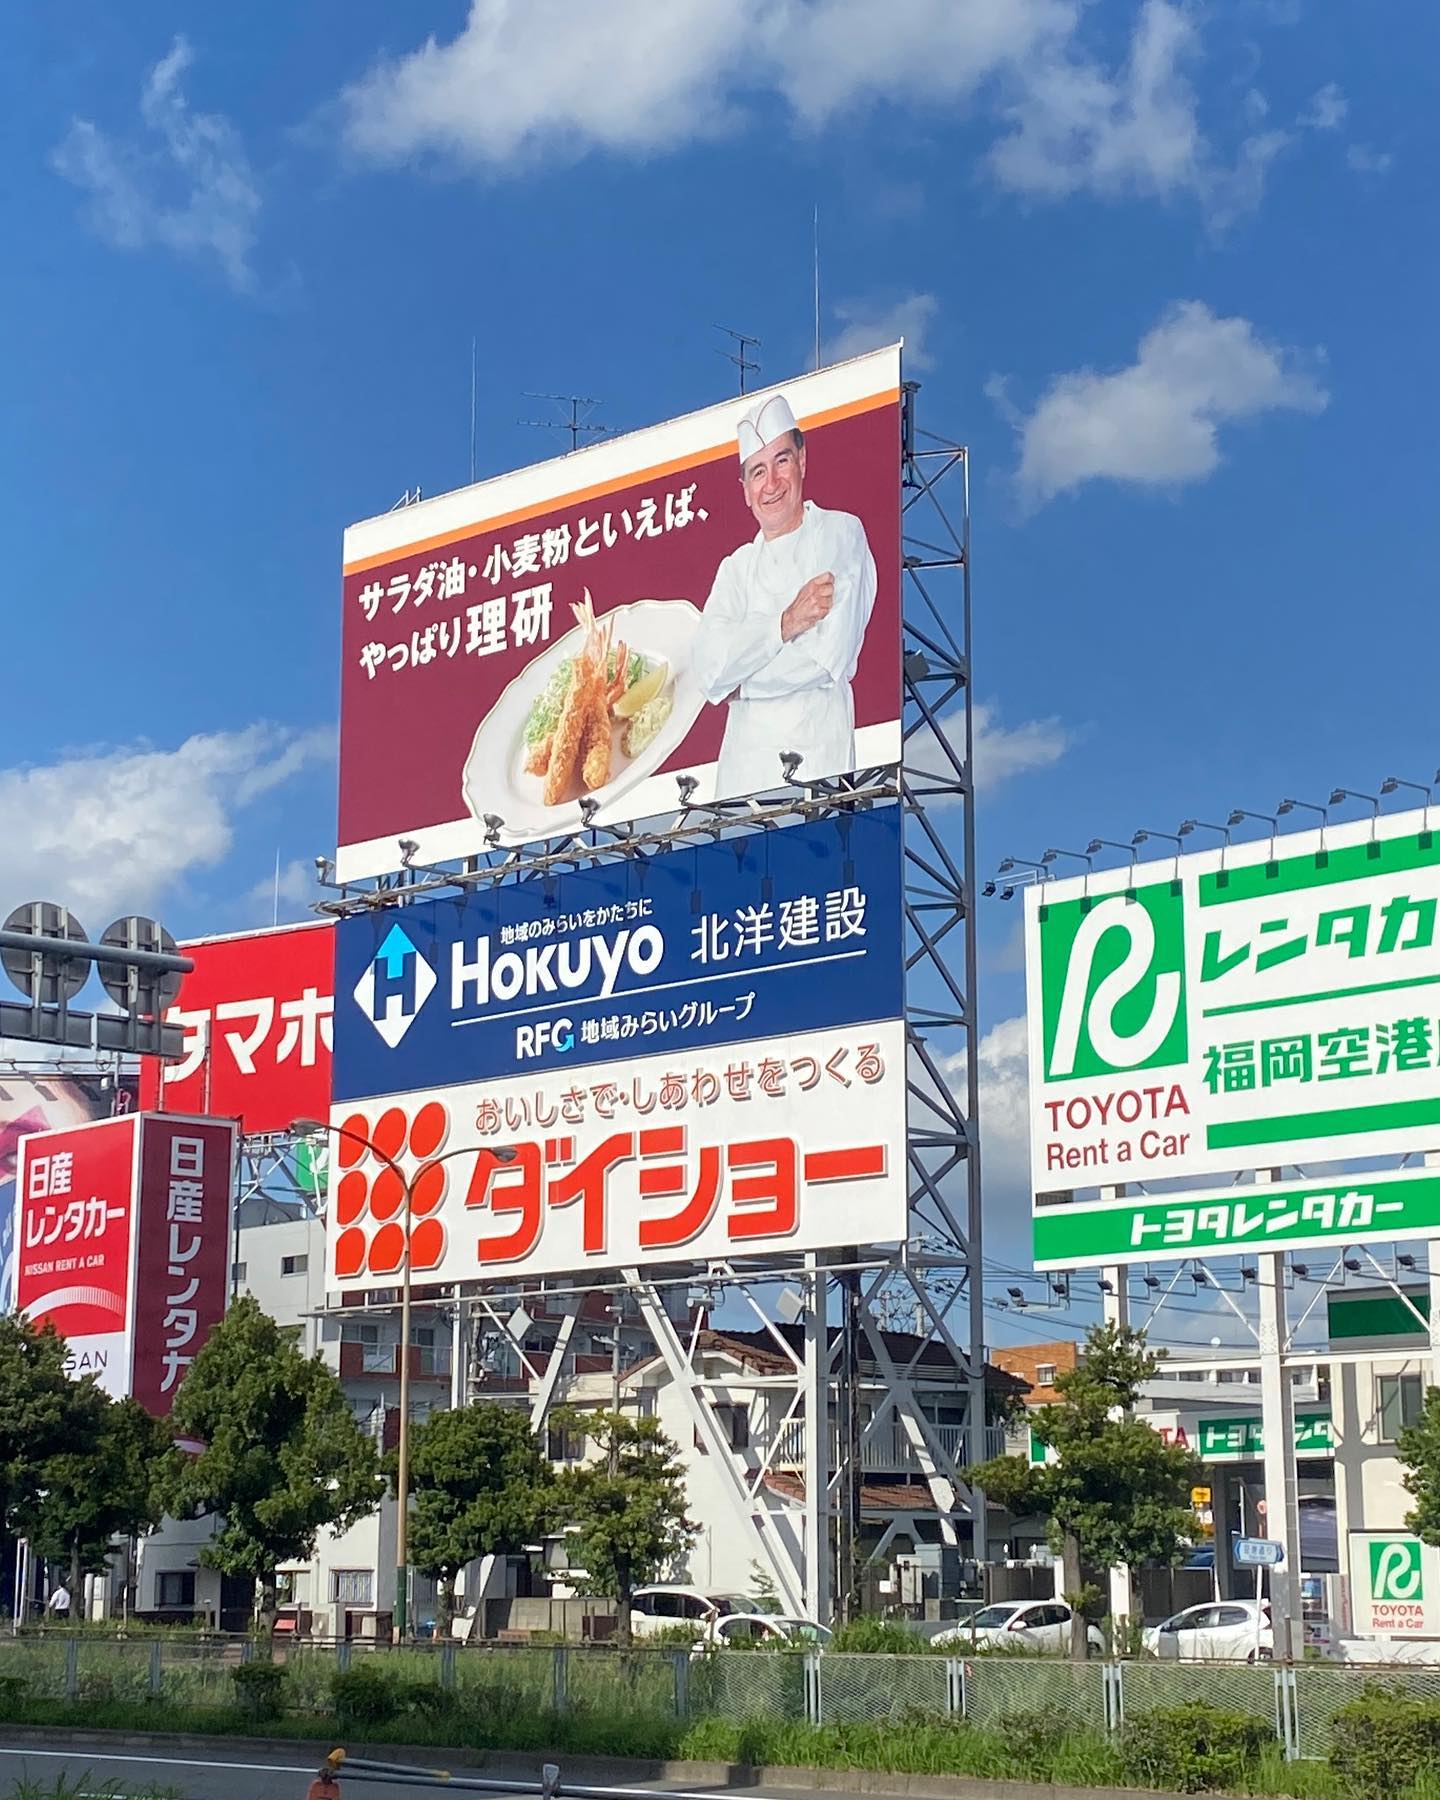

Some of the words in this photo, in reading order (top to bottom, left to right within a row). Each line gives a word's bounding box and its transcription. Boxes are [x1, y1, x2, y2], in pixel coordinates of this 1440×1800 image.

[359, 583, 554, 679] やっぱり理研
[501, 899, 653, 945] 地域のみらいをかたちに
[691, 887, 867, 963] 北洋建設
[581, 992, 755, 1044] 地域みらいグループ
[1202, 1016, 1440, 1095] 福岡空港
[1045, 1084, 1190, 1132] TOYOTA
[1046, 1138, 1108, 1170] Rent
[1117, 1142, 1132, 1161] a
[1139, 1130, 1190, 1160] Car
[29, 1152, 73, 1200] 日産
[465, 1125, 887, 1263] ダイショー
[26, 1196, 125, 1248] レンタカー
[1130, 1191, 1404, 1246] トヨタレンタカー
[24, 1260, 54, 1277] NISSAN
[55, 1257, 78, 1272] RENT
[79, 1256, 85, 1269] A
[86, 1254, 105, 1268] CAR
[1371, 1604, 1424, 1616] TOYOTA
[1372, 1617, 1395, 1629] Rent
[1405, 1617, 1425, 1629] Car
